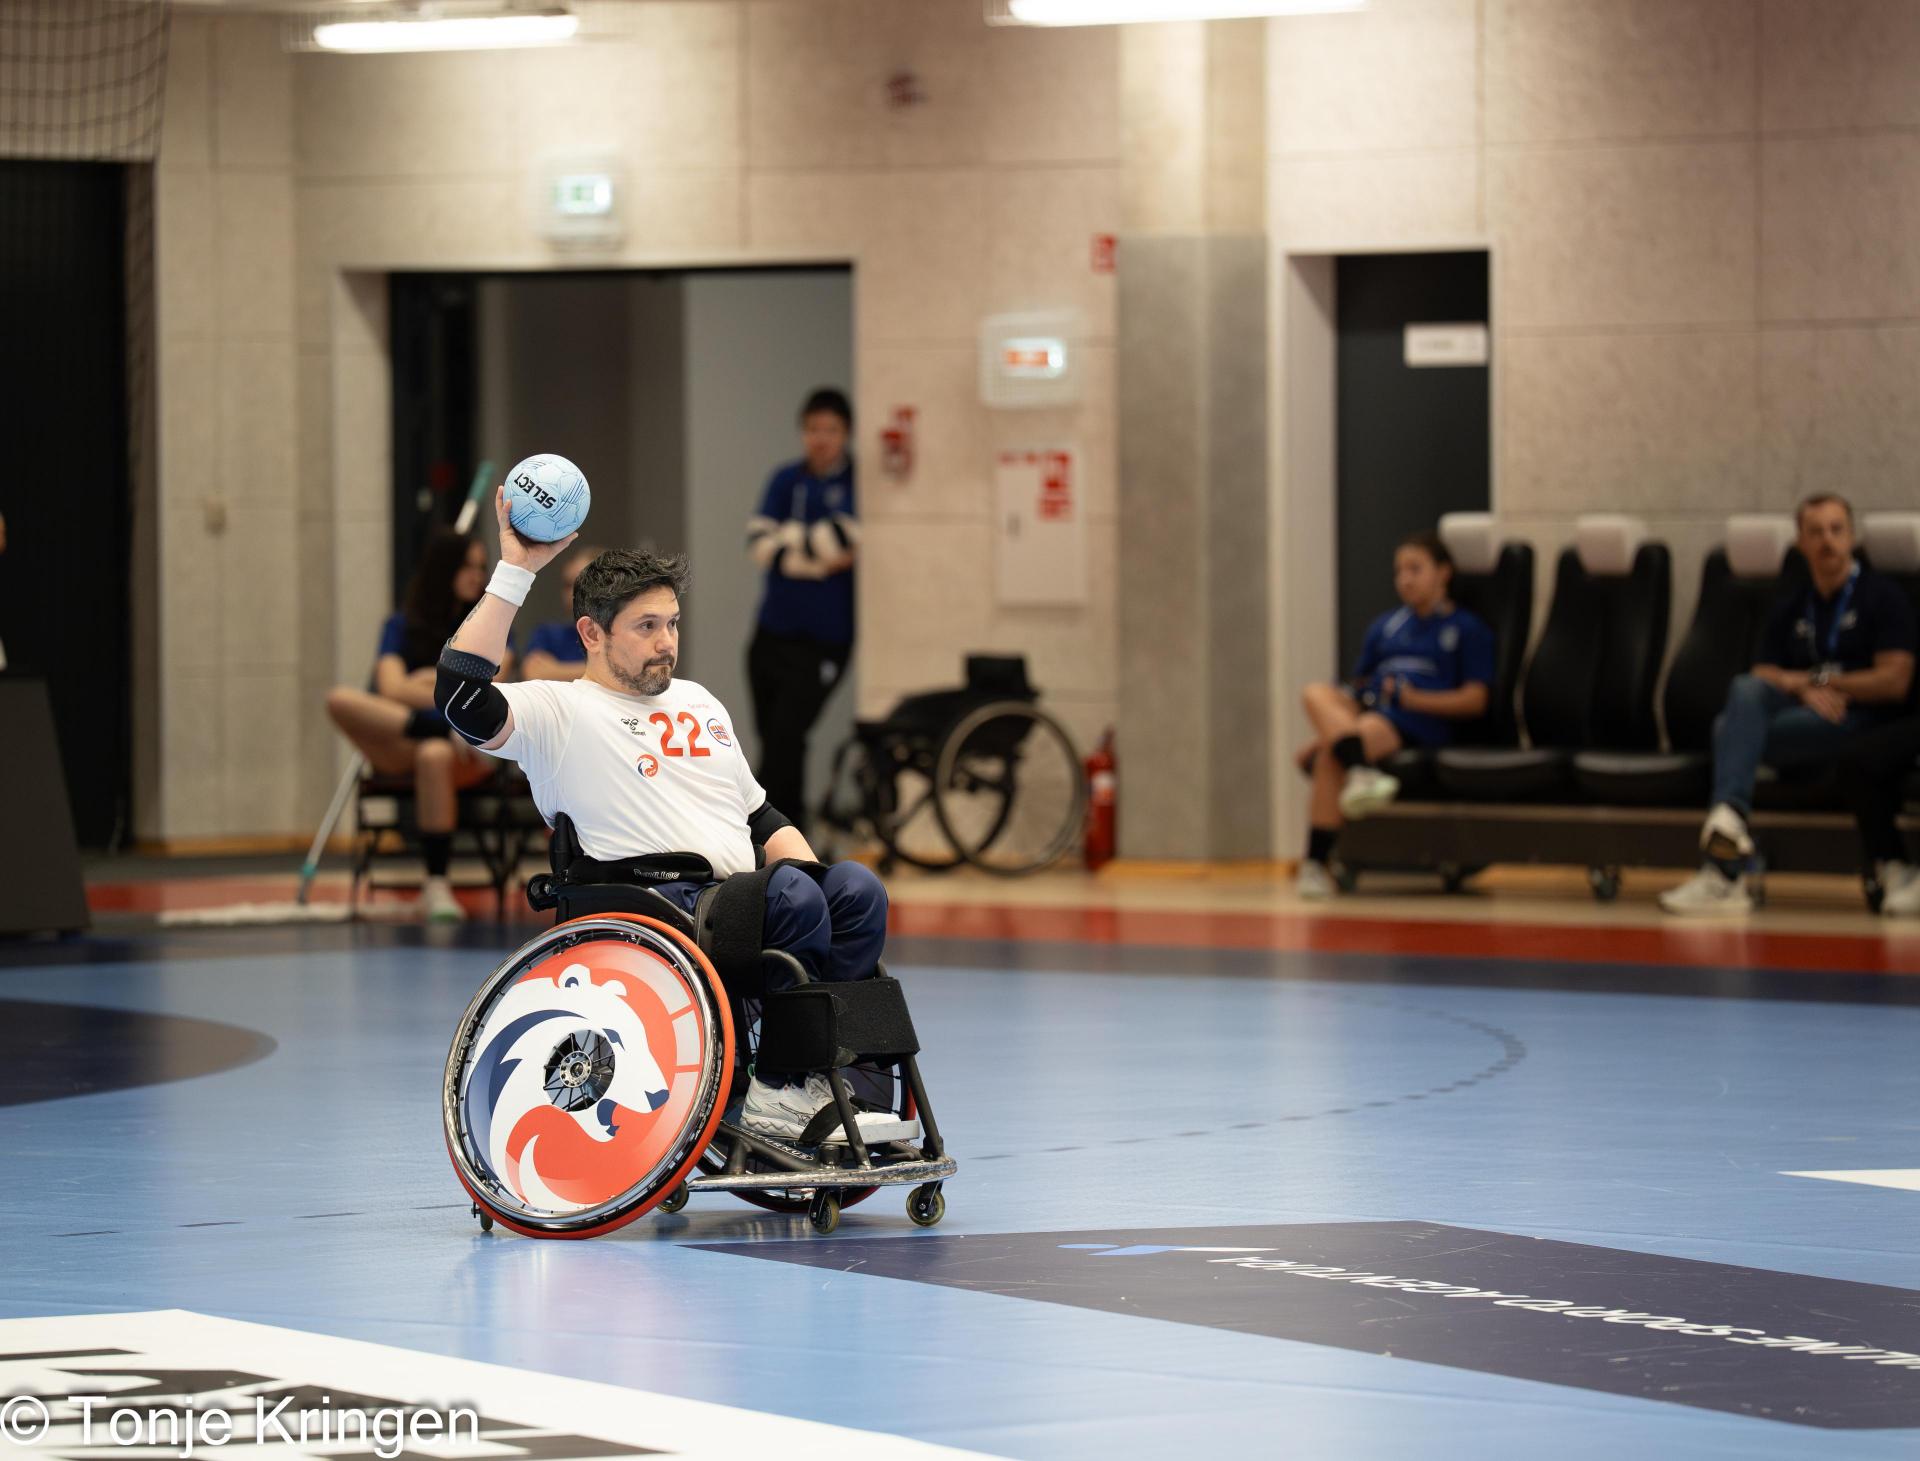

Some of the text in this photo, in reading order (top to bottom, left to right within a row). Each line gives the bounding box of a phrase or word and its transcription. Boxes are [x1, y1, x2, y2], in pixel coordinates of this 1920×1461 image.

[514, 473, 557, 509] SELECT
[649, 711, 711, 757] 22
[1493, 1299, 1766, 1337] SPORTO
